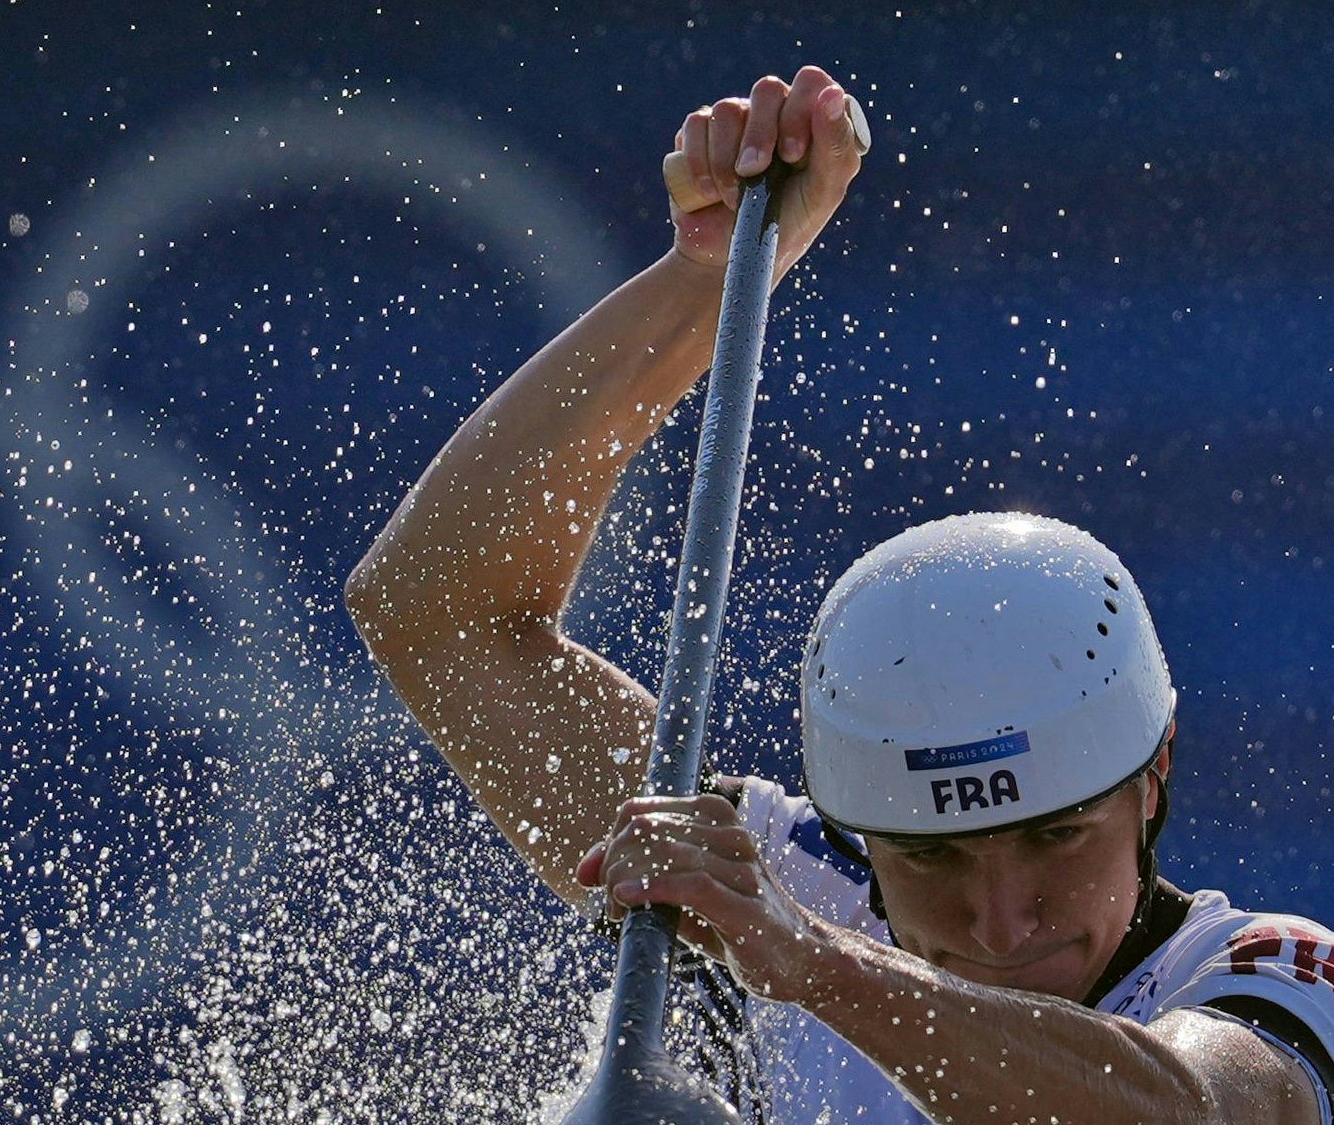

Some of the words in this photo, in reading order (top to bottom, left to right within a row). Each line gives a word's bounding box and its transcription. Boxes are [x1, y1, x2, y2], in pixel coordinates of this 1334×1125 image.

[940, 749, 977, 763] PARIS
[980, 741, 1015, 757] 2024
[930, 769, 1020, 814] FRA
